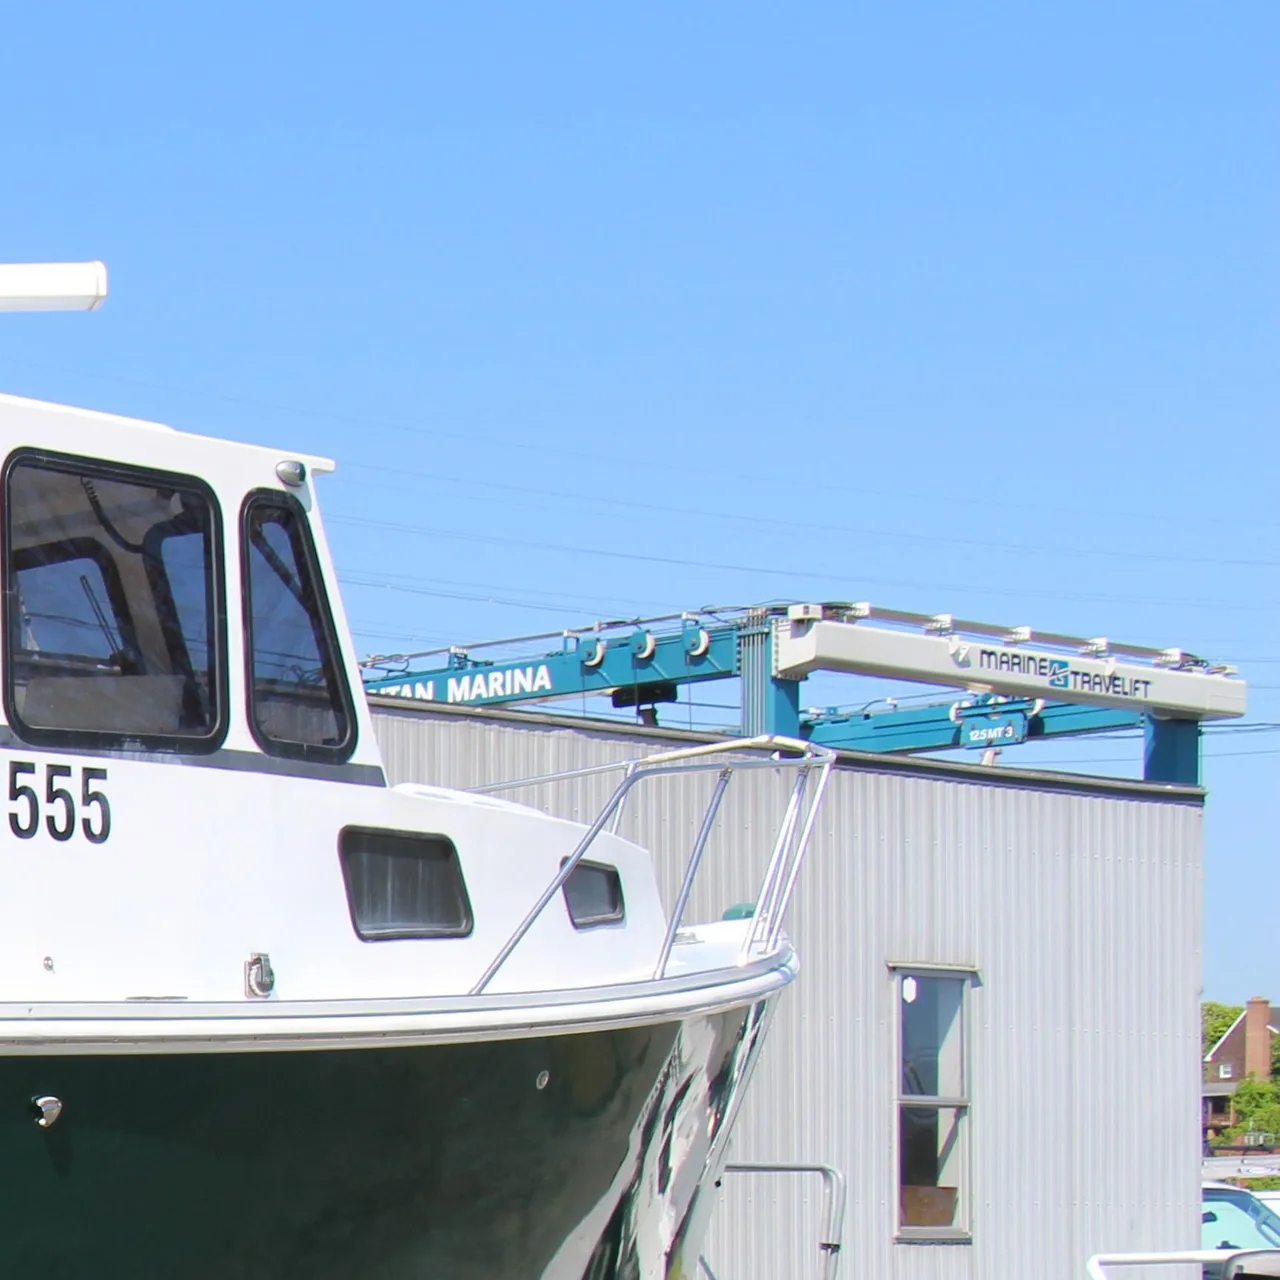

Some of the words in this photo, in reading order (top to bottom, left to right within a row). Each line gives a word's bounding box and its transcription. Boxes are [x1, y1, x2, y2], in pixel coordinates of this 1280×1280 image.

[447, 664, 552, 703] MARINA
[980, 649, 1048, 677] MARINE
[1070, 670, 1151, 698] TRAVELIFT
